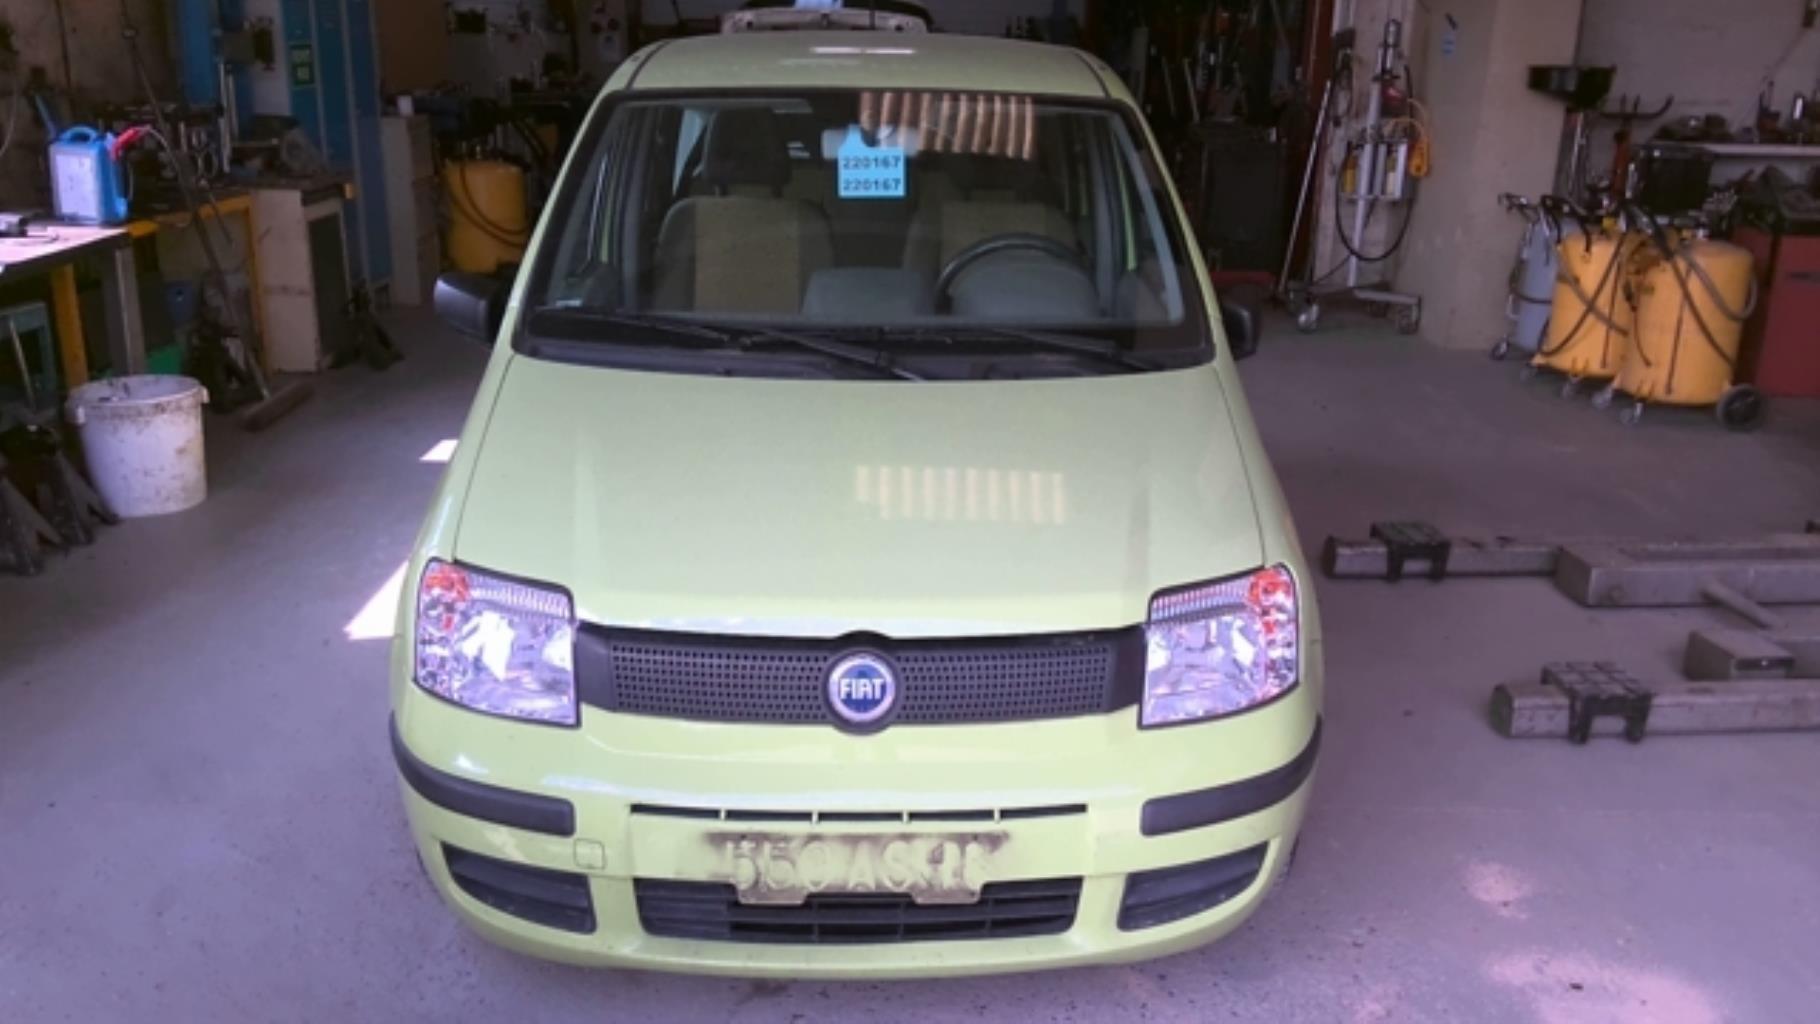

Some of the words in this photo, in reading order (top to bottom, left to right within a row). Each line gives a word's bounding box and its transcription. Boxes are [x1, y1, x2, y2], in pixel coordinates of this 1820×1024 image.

[842, 154, 903, 169] 220167
[842, 177, 903, 192] 220167
[840, 677, 886, 700] FIAT
